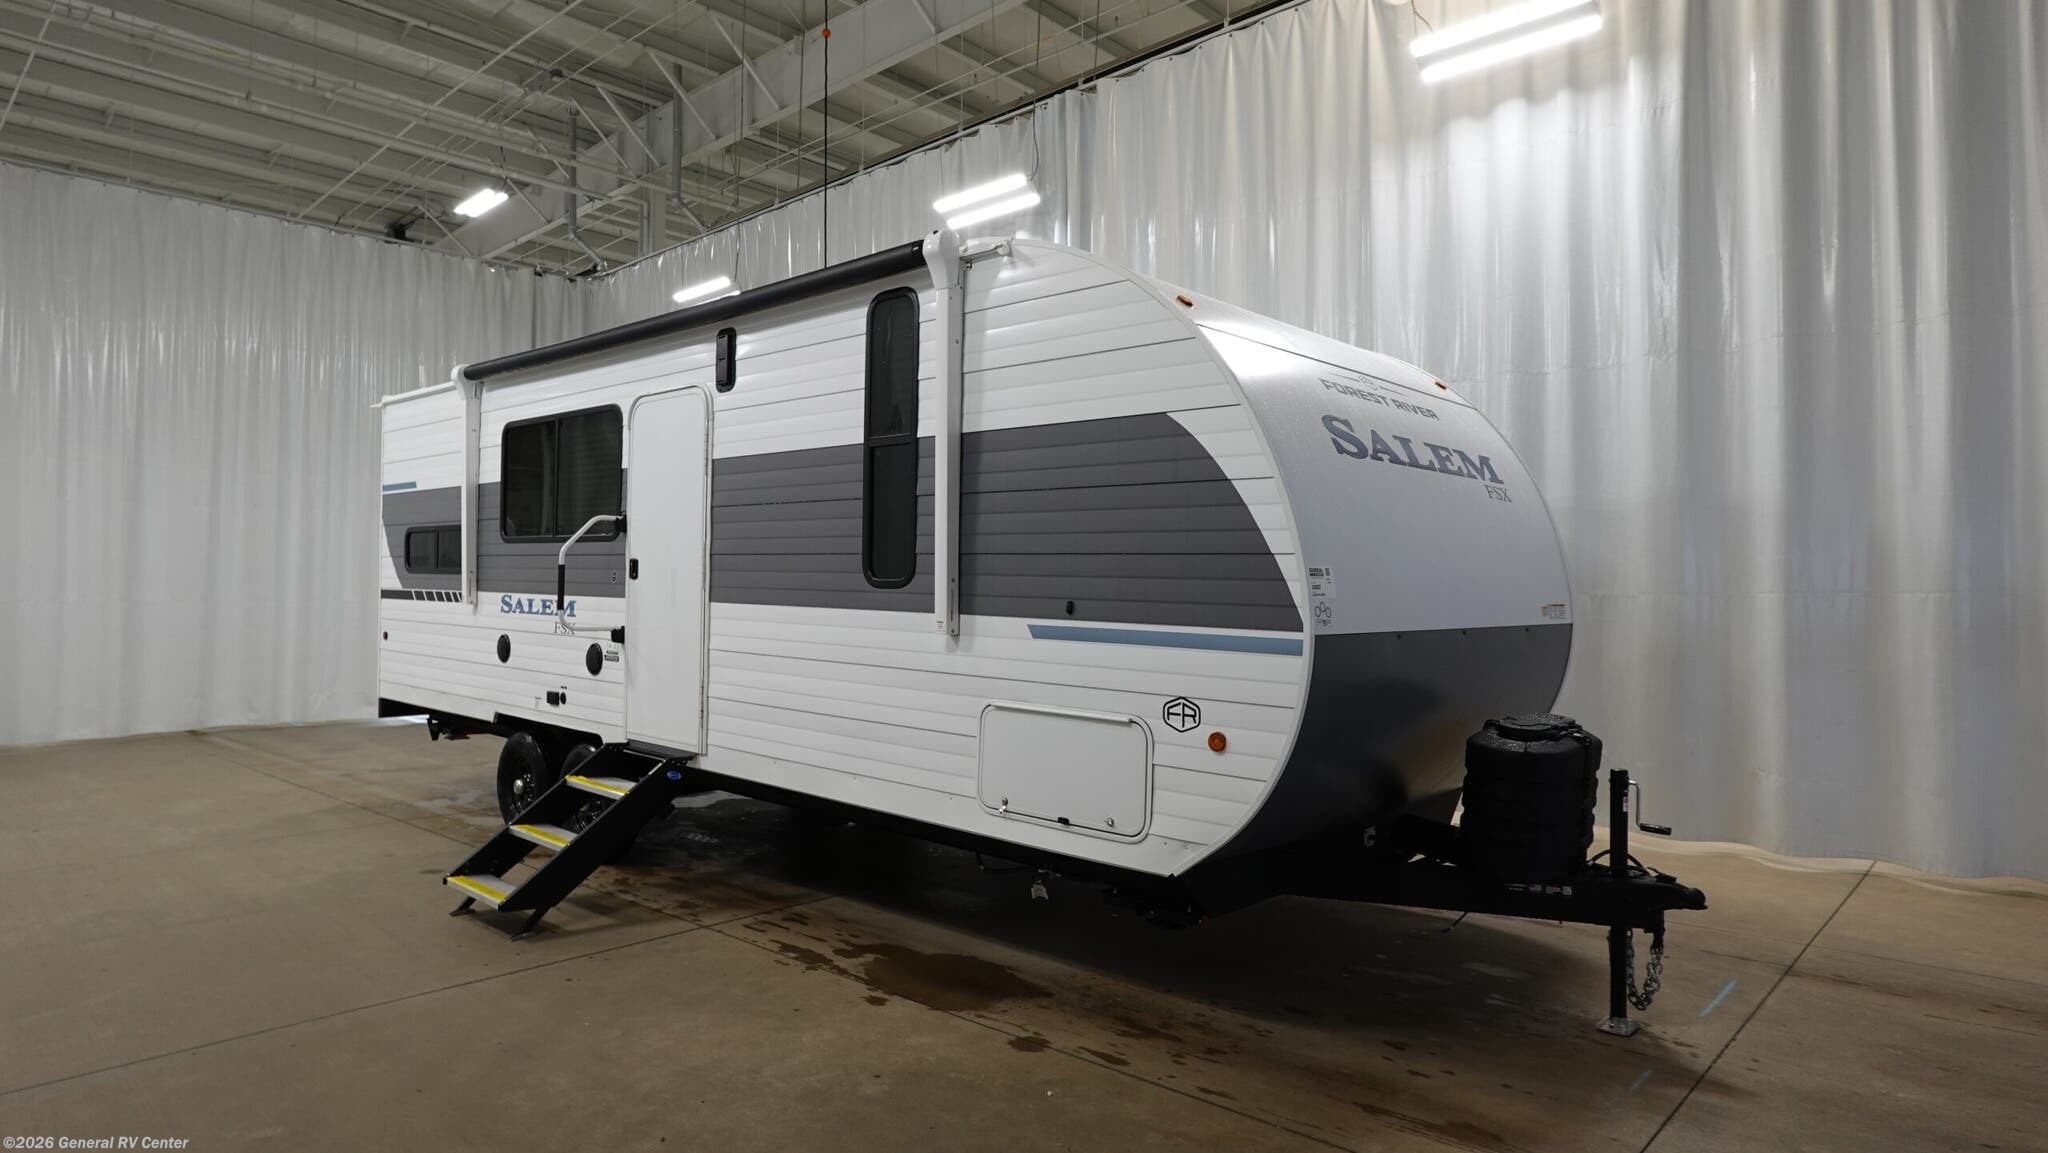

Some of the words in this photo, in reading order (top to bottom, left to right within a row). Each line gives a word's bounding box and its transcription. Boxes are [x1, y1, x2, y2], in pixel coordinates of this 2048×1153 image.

[1319, 378, 1390, 406] FOREST
[1391, 398, 1440, 420] RIVER
[1321, 414, 1505, 484] SALEM
[1485, 484, 1512, 502] FSX
[500, 594, 577, 618] SALEM
